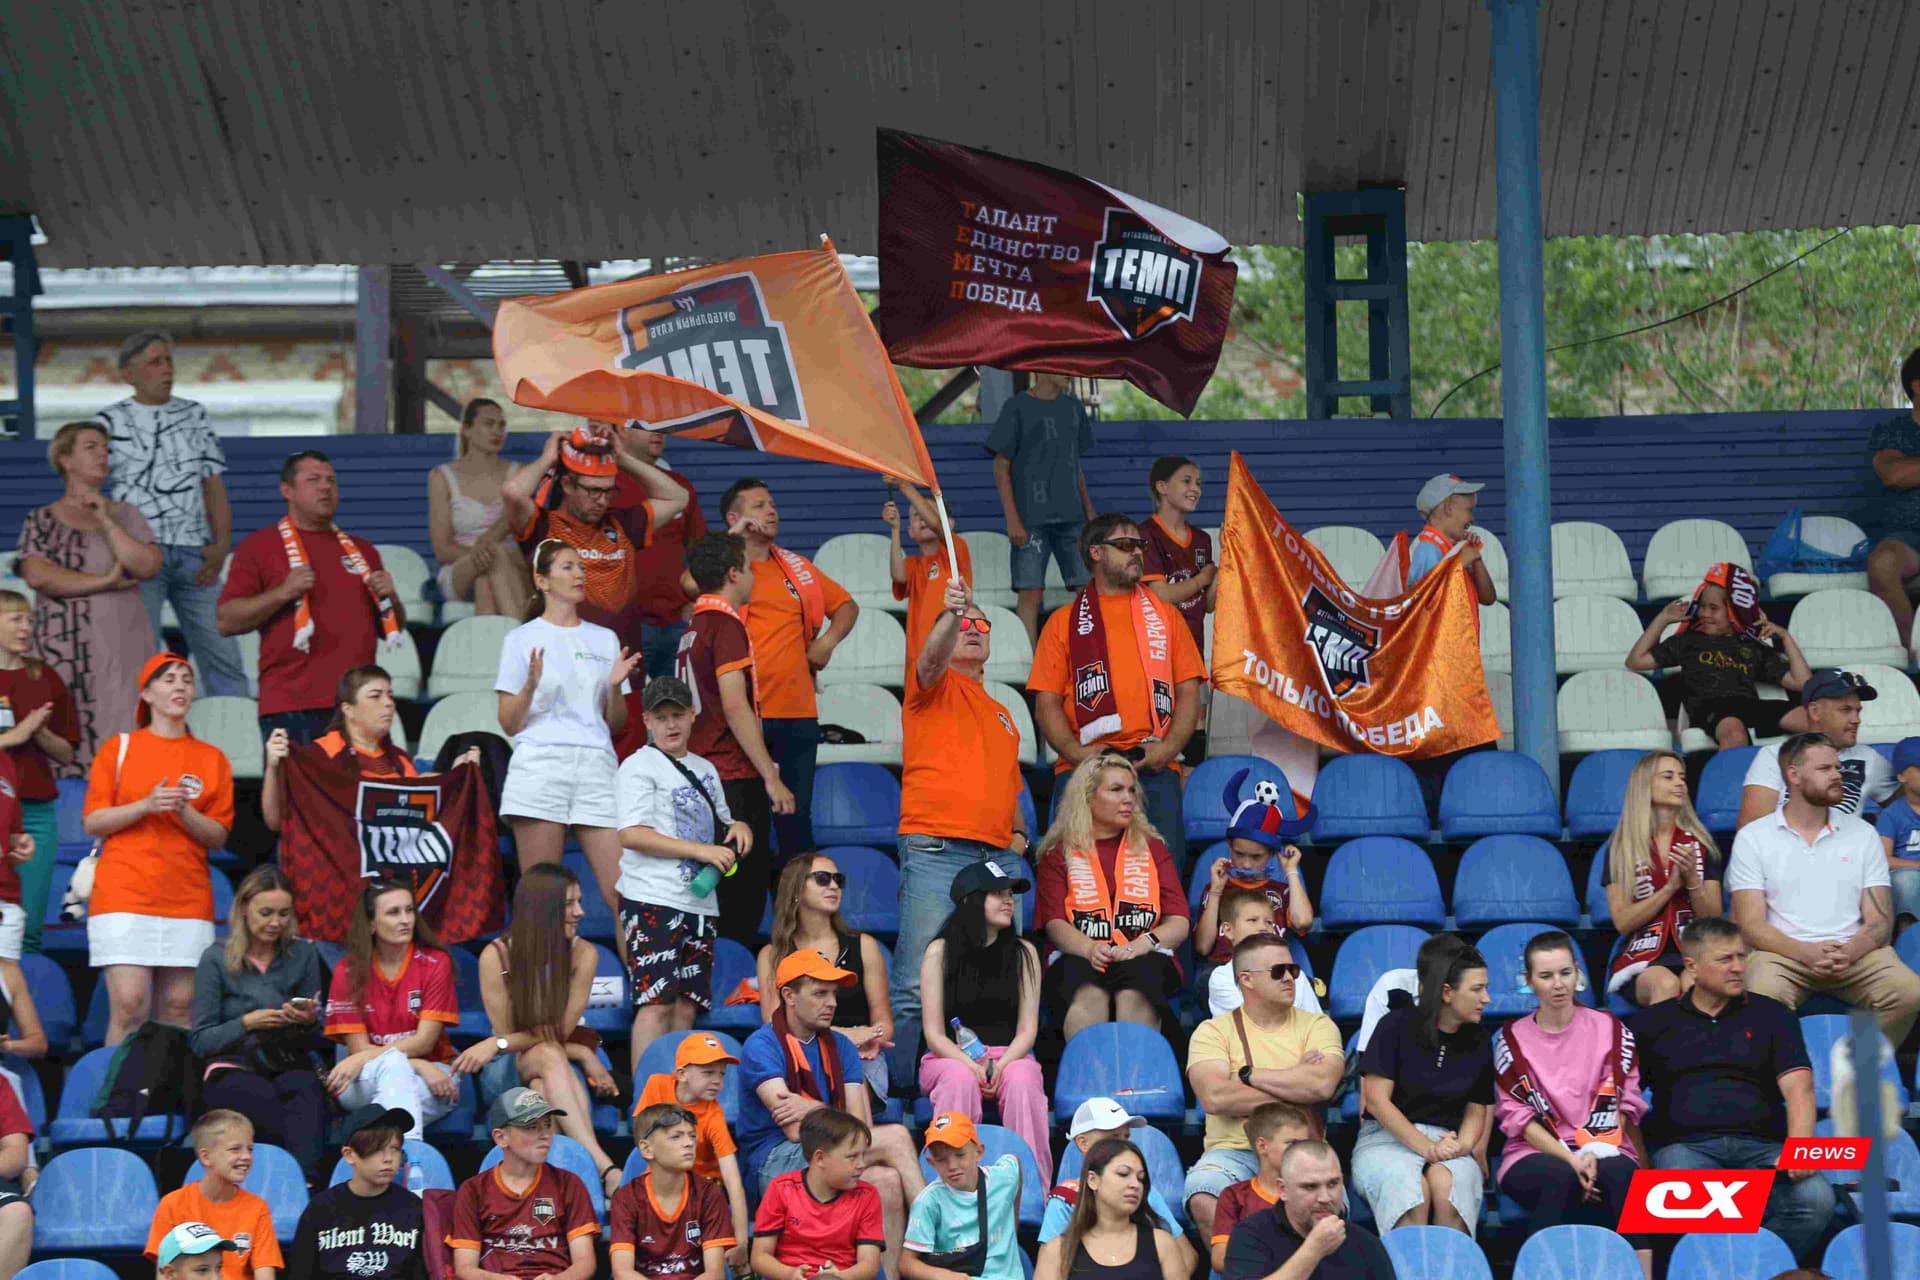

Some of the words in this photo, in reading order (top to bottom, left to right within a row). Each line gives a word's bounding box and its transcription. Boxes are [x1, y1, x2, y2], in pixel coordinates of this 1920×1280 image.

[960, 200, 1058, 235] ТАЛАНТ
[956, 224, 1080, 263] ЕДИНСТВО
[952, 251, 1033, 282] МЕЧТА
[1103, 247, 1190, 305] ТЕМП
[950, 280, 1042, 313] ПОБЕДА
[1313, 624, 1372, 675] ЕМП
[1078, 675, 1106, 699] ТЕМП
[1242, 648, 1331, 719] ТОЛЬКО
[1334, 705, 1444, 746] ПОБЕДА
[366, 825, 448, 864] ТЕМП
[1079, 919, 1109, 938] ЕМП
[1117, 911, 1154, 929] ТЕМП
